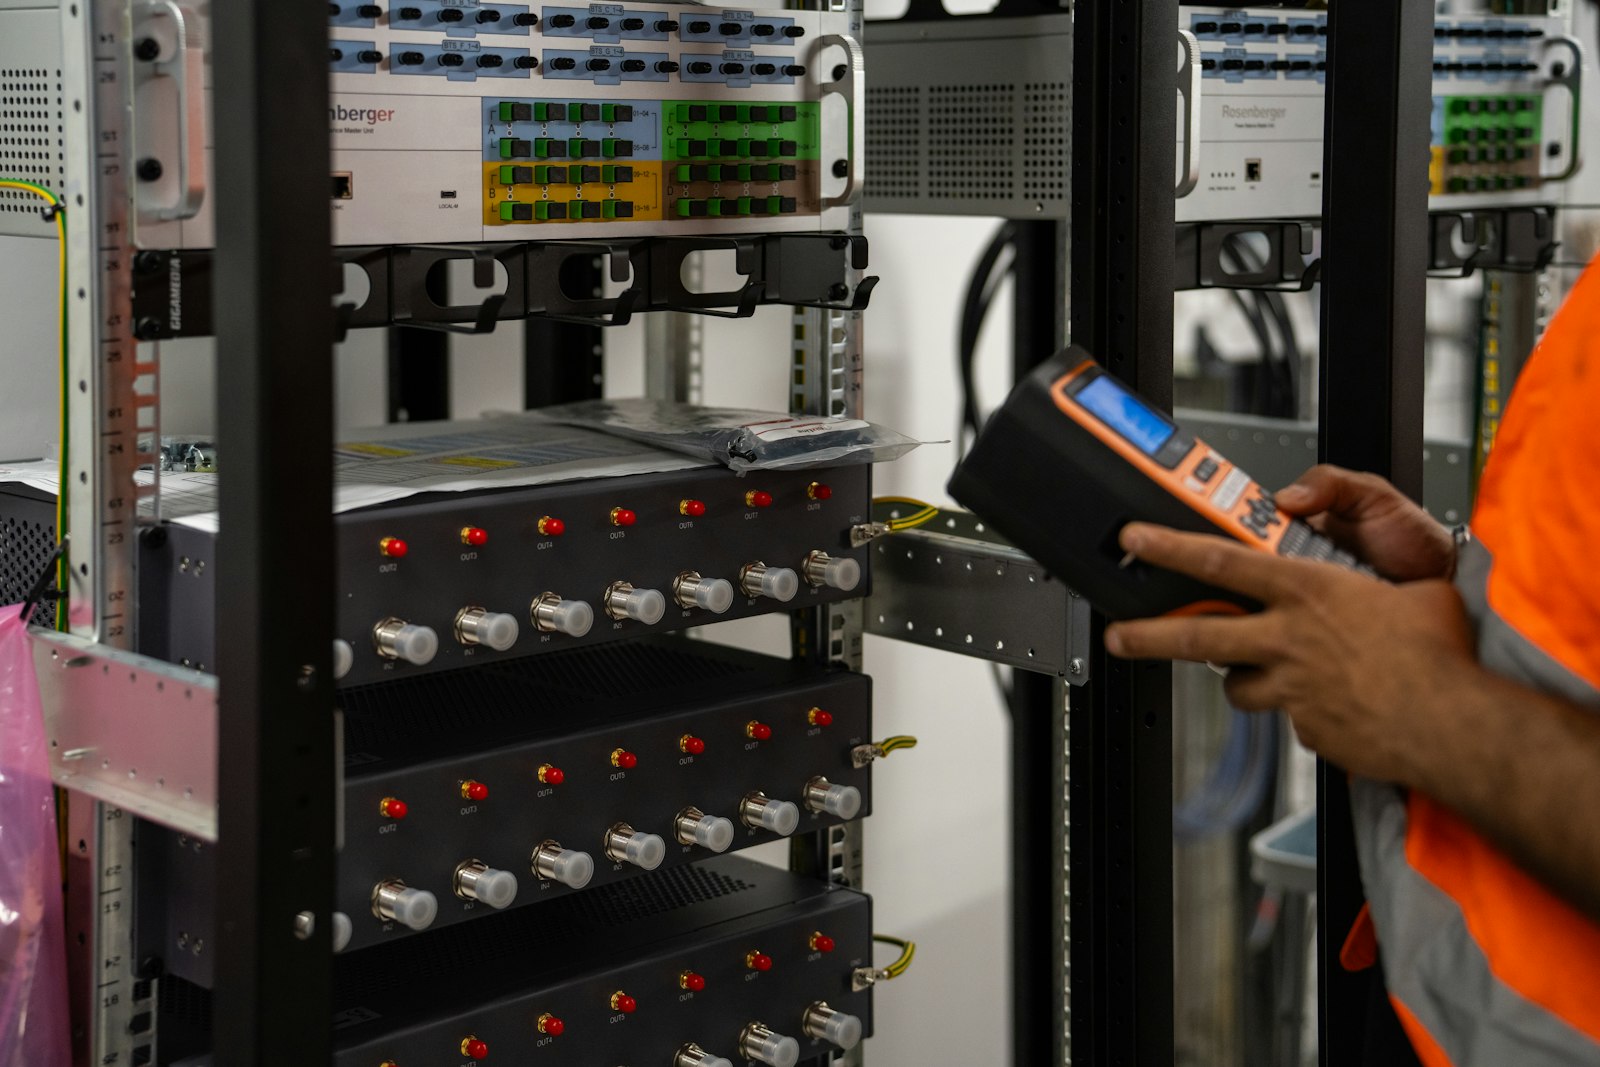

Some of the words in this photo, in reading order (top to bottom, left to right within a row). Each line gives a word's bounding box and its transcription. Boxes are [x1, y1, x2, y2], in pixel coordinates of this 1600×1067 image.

[1222, 105, 1287, 121] Rosenberger
[488, 124, 496, 135] A
[666, 126, 674, 136] C
[489, 188, 497, 199] B
[667, 186, 674, 196] D
[744, 512, 759, 521] OUT7
[678, 521, 694, 530] OUT6
[610, 531, 625, 540] OUT5
[537, 542, 553, 551] OUT4
[460, 552, 477, 561] OUT3
[379, 563, 397, 573] OUT2
[679, 757, 694, 766] OUT6
[610, 772, 625, 782] OUT5
[537, 788, 553, 798] OUT4
[460, 806, 477, 816] OUT3
[379, 824, 397, 834] OUT2
[610, 1013, 625, 1024] OUT5
[537, 1037, 553, 1047] OUT4
